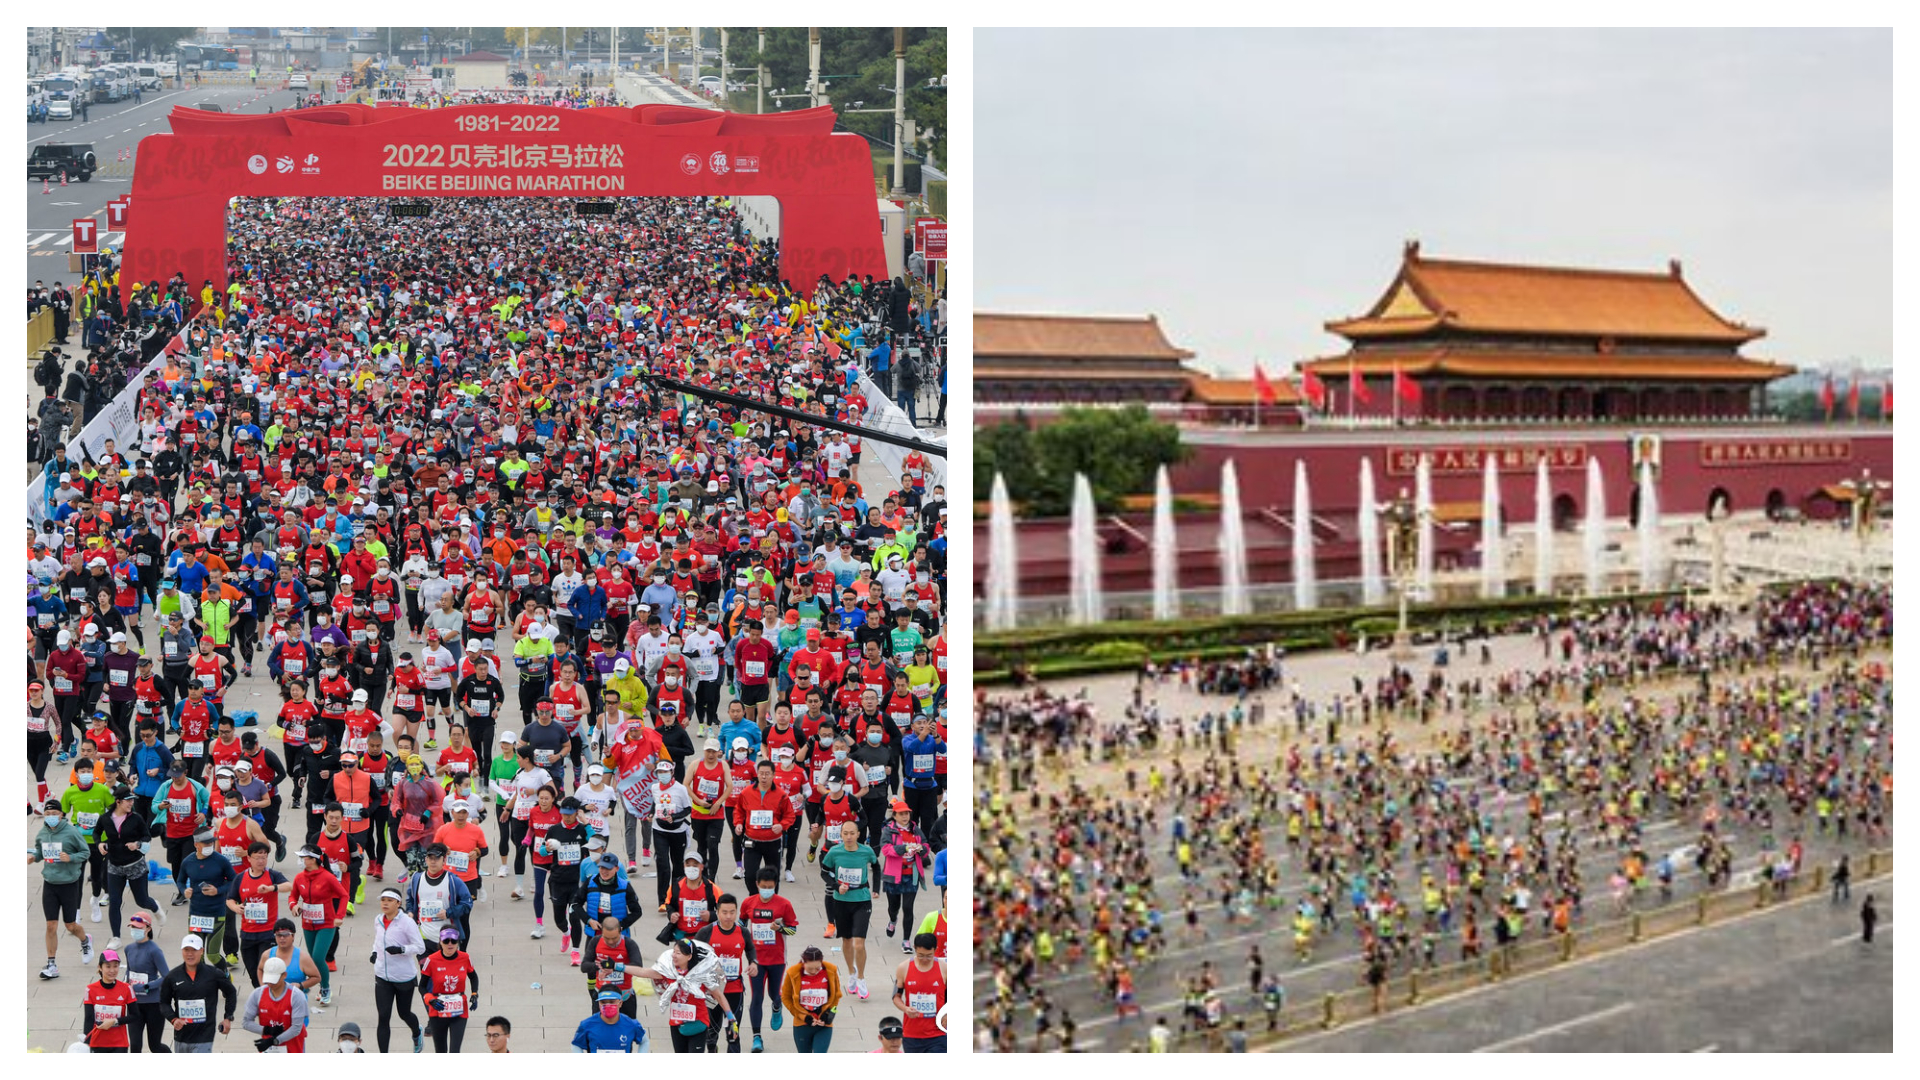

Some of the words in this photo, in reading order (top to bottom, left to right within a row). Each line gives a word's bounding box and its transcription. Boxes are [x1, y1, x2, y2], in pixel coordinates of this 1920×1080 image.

[714, 157, 727, 167] 40
[382, 175, 437, 190] BEIKE
[441, 175, 512, 190] BEIJING
[516, 175, 625, 190] MARATHON
[110, 204, 127, 221] T
[76, 222, 94, 241] T
[180, 1007, 204, 1017] D0052
